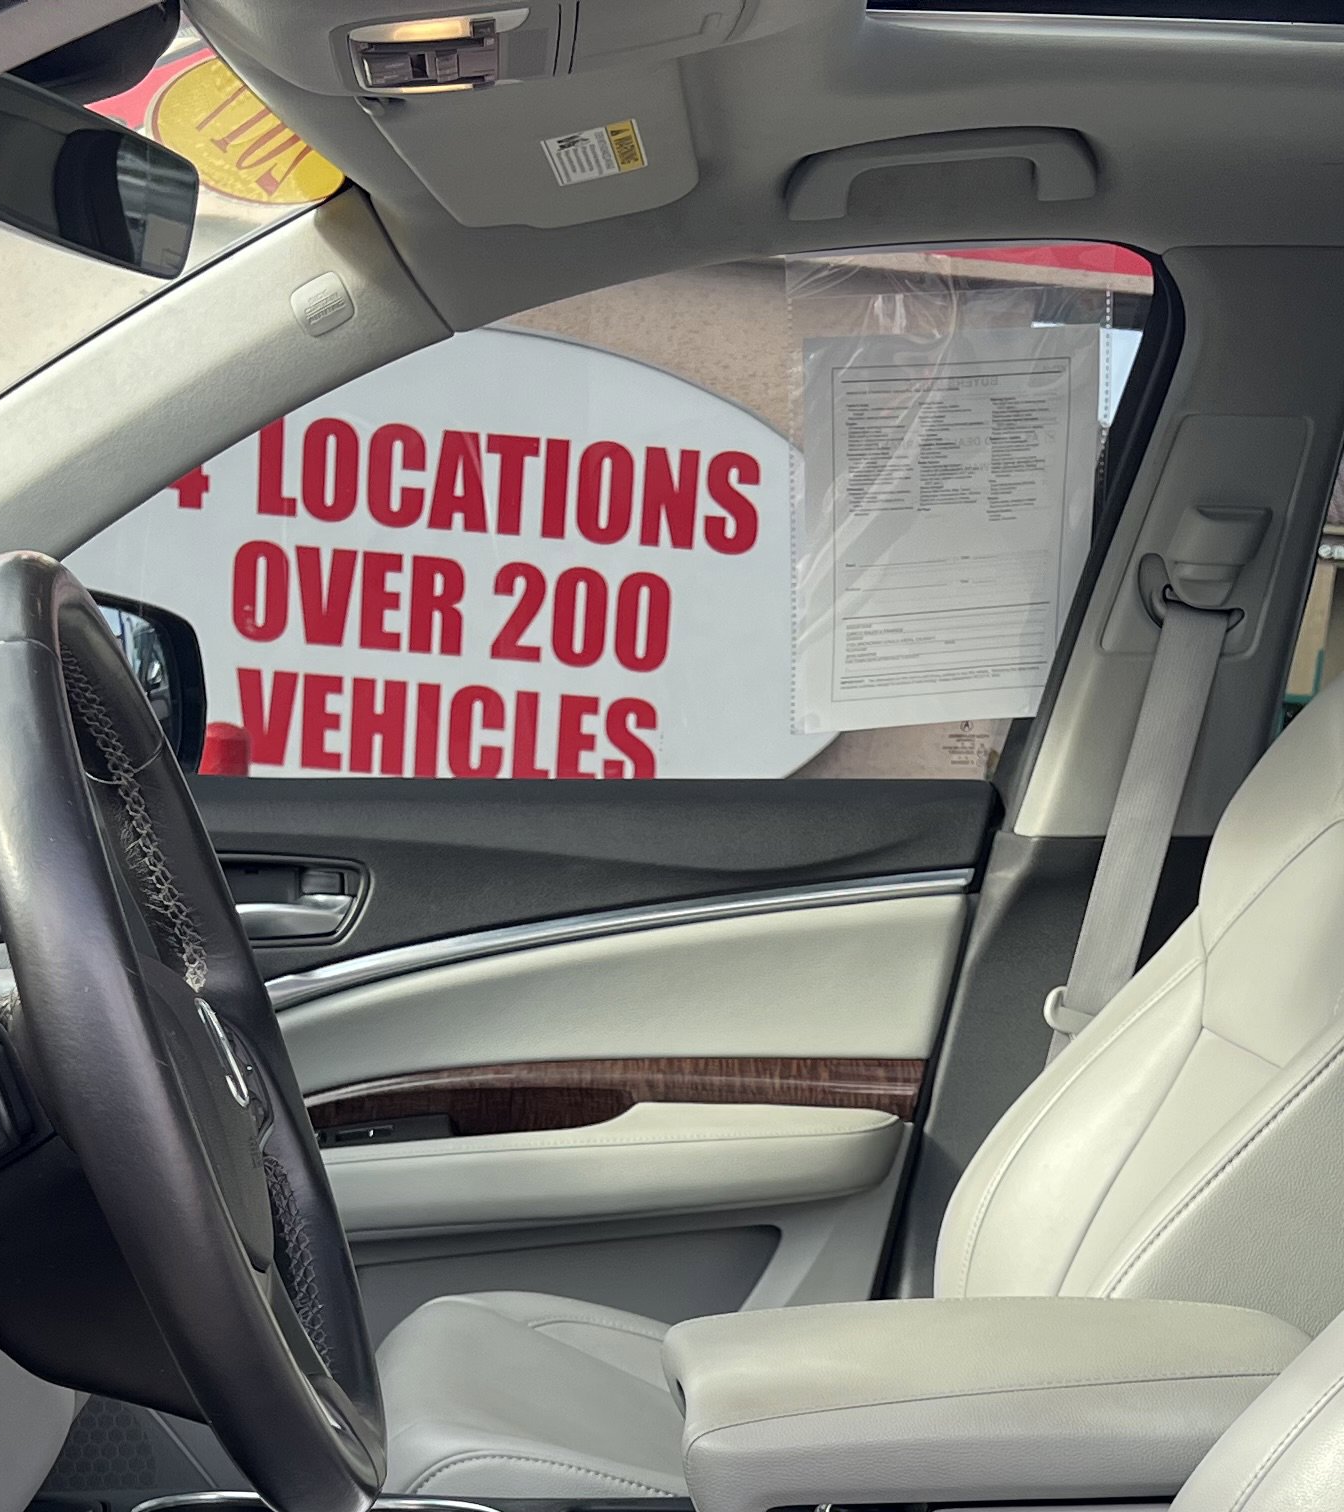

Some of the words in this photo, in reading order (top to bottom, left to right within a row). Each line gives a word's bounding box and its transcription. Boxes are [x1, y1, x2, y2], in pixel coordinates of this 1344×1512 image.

[256, 416, 762, 556] LOCATIONS
[231, 539, 465, 657] OVER
[490, 561, 672, 674] 200
[236, 667, 658, 779] VEHICLES
